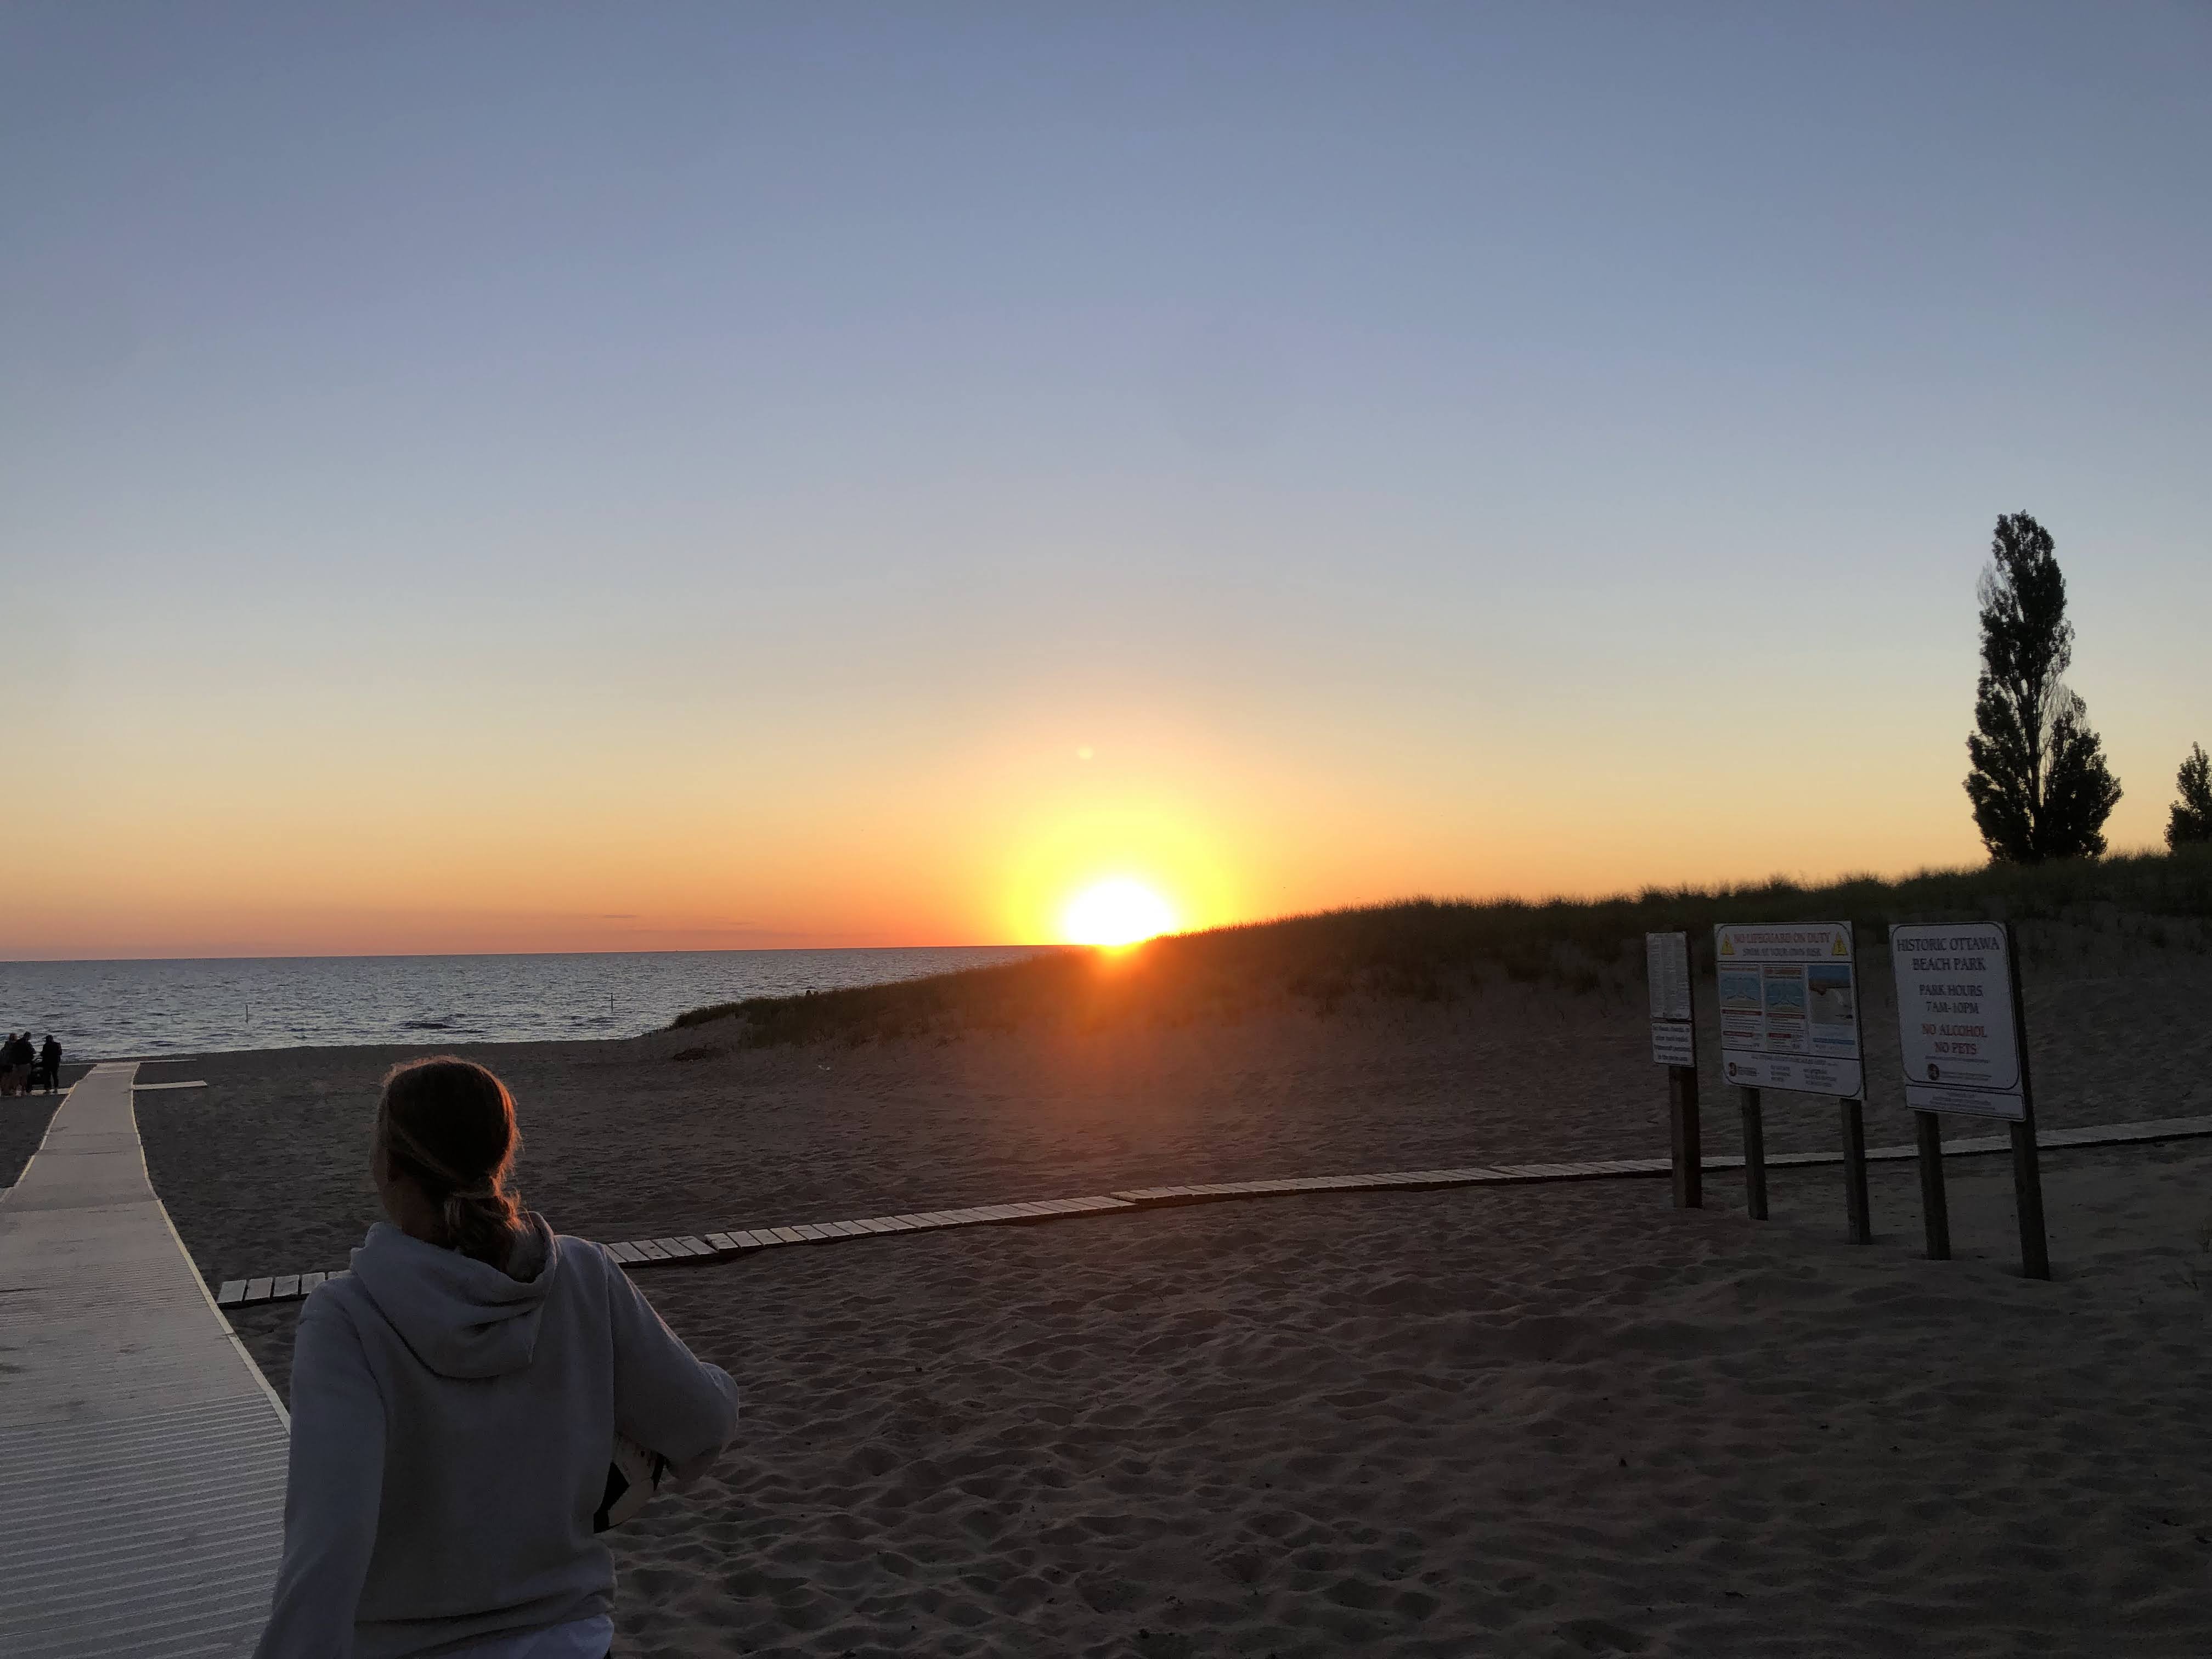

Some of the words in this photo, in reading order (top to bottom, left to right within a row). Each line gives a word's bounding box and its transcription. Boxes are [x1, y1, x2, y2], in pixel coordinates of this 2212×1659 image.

[1897, 938, 1947, 951] HISTORIC
[1949, 937, 2000, 950] OTTAWA
[1912, 958, 1950, 970] BEACH
[1954, 957, 1986, 970] PARK
[1919, 984, 1944, 996] PARK
[1948, 984, 1983, 996] HOURS
[1922, 1023, 1936, 1035] NO
[1939, 1024, 1988, 1037] ALCOHOL
[1935, 1041, 1949, 1053] NO
[1952, 1042, 1977, 1054] PETS
